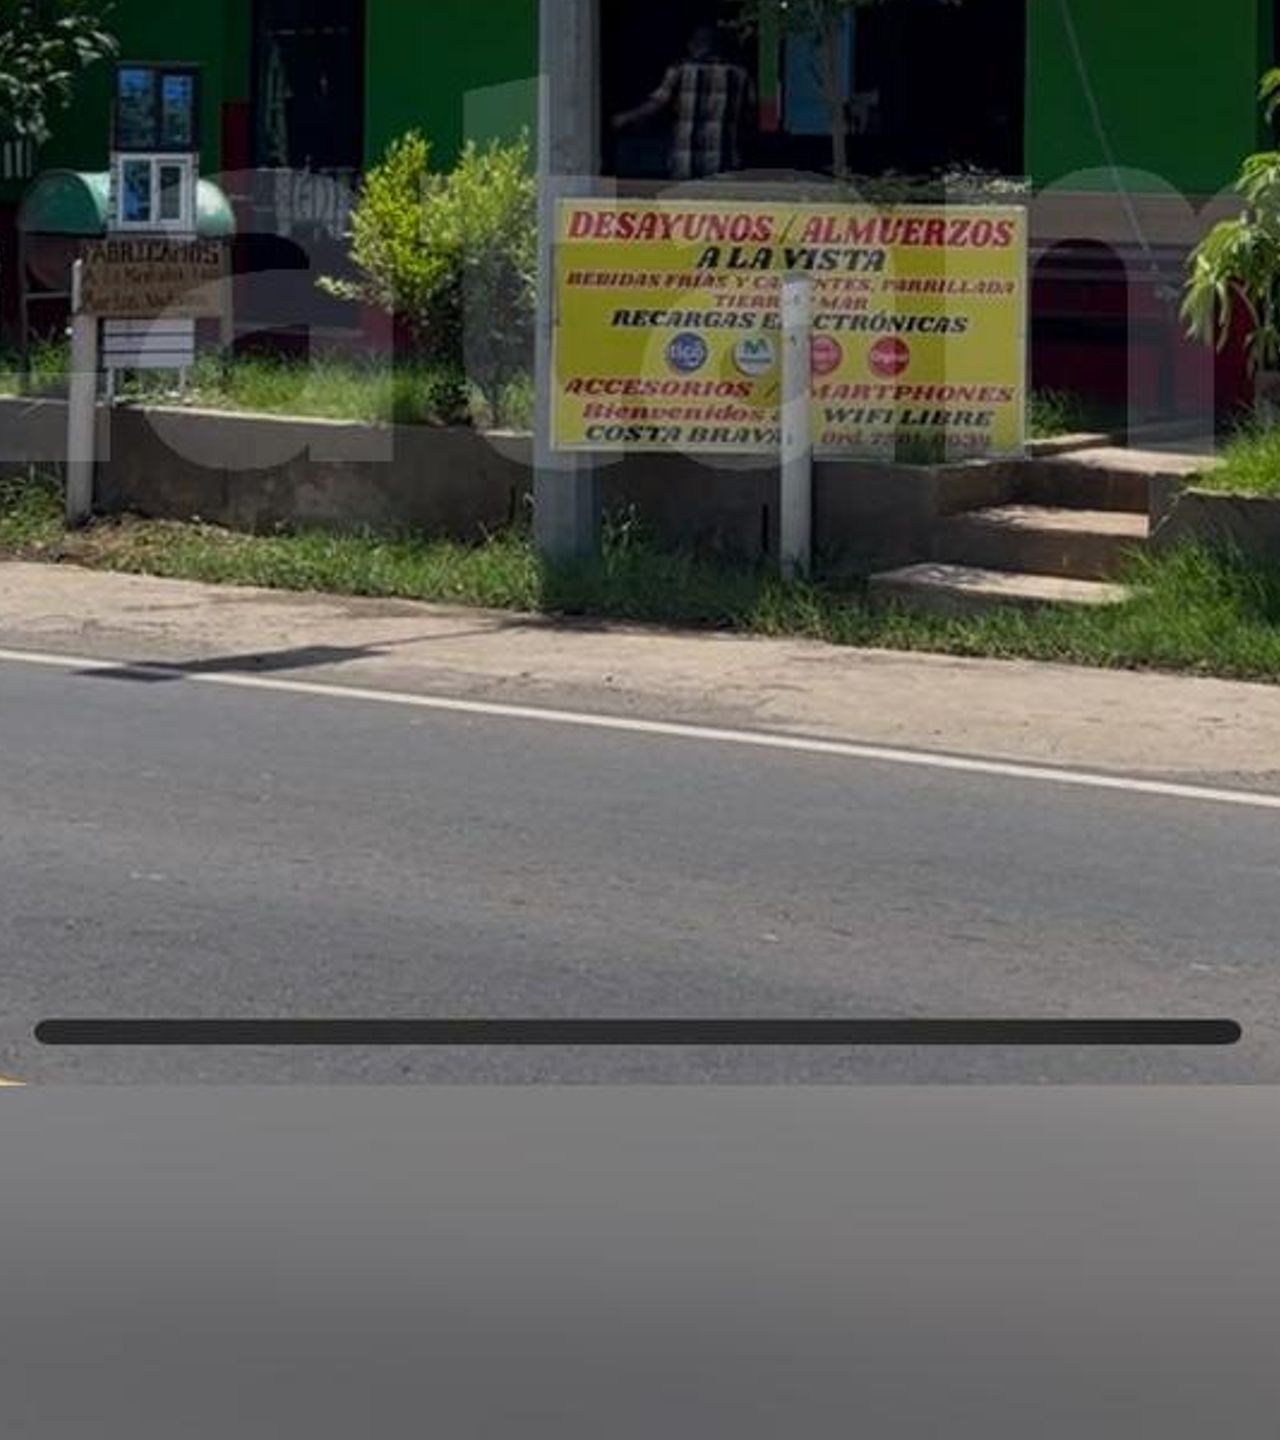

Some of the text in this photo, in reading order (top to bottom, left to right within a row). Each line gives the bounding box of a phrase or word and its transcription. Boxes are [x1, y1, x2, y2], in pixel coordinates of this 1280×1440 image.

[568, 211, 773, 242] DESAYUNOS
[801, 216, 1014, 246] ALMUERZOS
[698, 247, 886, 271] A LA VISTA
[566, 272, 661, 287] BEBIDAS
[883, 278, 1014, 295] PARRILLADA
[612, 310, 756, 328] RECARGAS
[565, 378, 753, 397] ACCESORIOS
[583, 403, 765, 422] Bienvenidos
[825, 407, 893, 423] WIFI
[903, 410, 995, 426] LIBRE
[585, 425, 681, 443] COSTA
